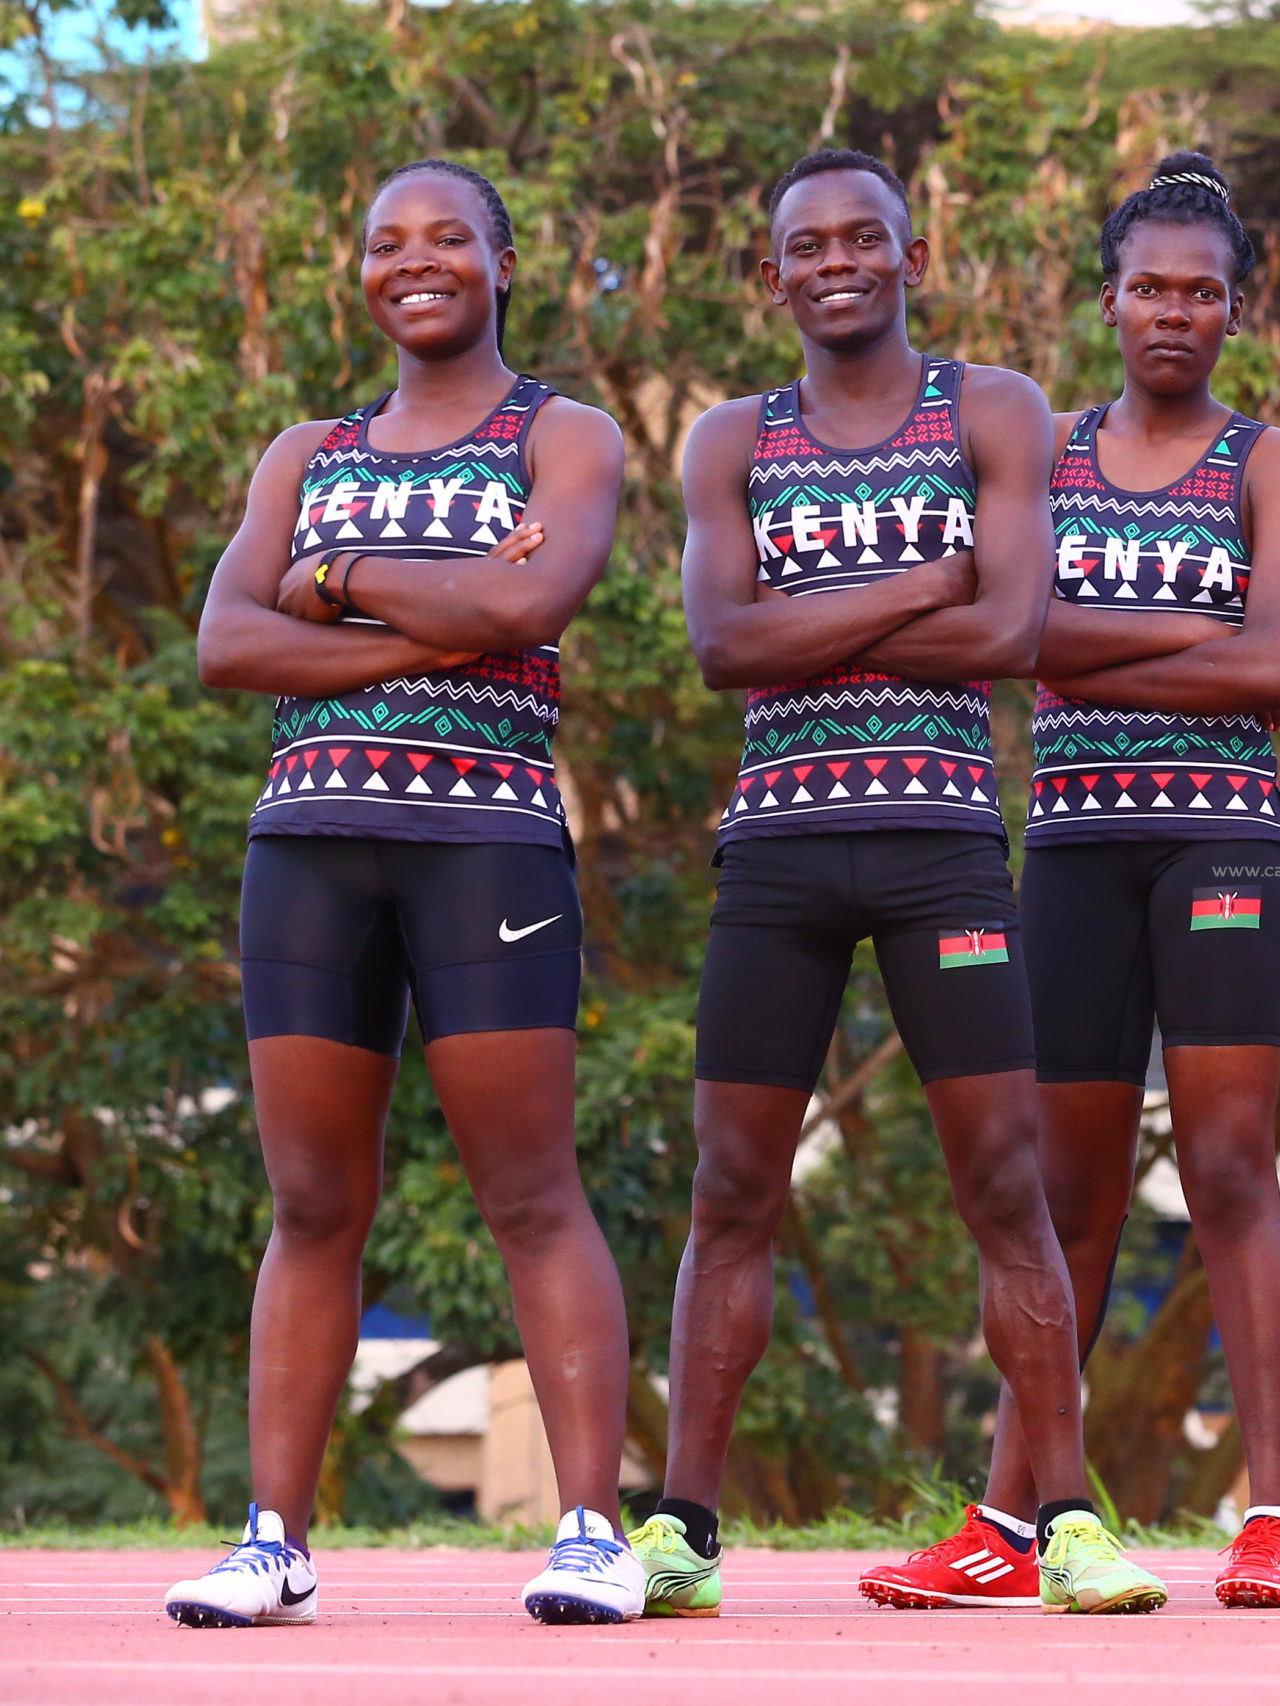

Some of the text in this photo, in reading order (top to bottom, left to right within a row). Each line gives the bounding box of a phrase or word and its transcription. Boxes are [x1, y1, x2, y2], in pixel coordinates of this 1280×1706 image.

[300, 478, 516, 531] KENYA
[753, 496, 975, 562] KENYA
[1057, 535, 1233, 592] ENYA
